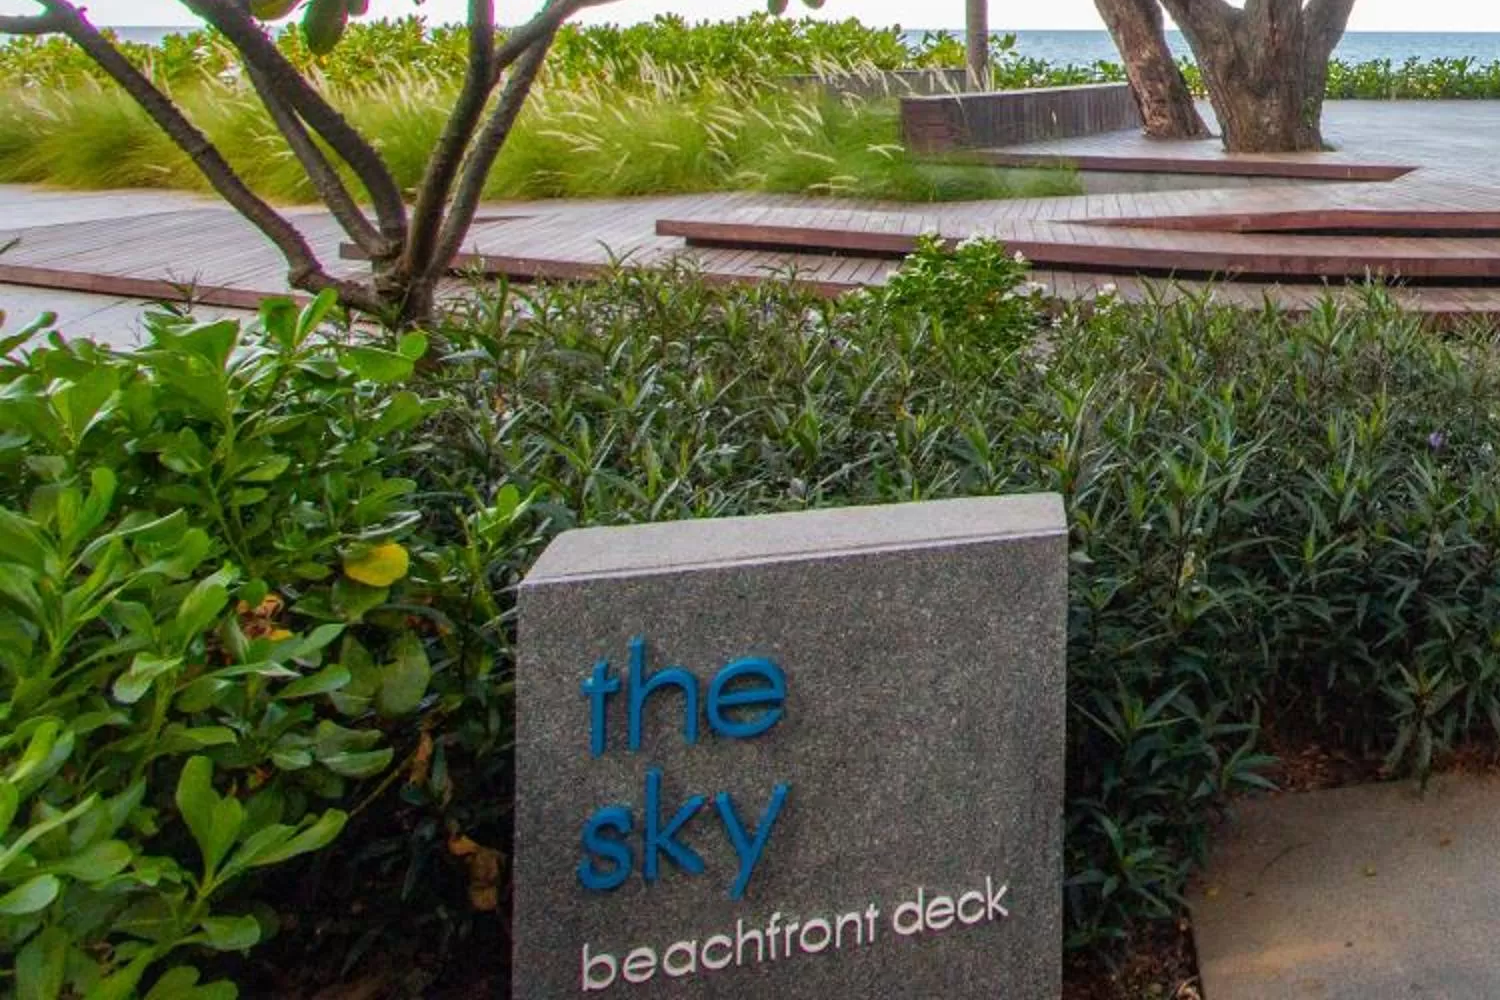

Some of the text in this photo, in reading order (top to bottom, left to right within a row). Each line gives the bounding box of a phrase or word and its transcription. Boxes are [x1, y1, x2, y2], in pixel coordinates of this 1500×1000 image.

[581, 635, 788, 758] the
[577, 768, 792, 899] sky
[581, 876, 1009, 991] beachfront deck
